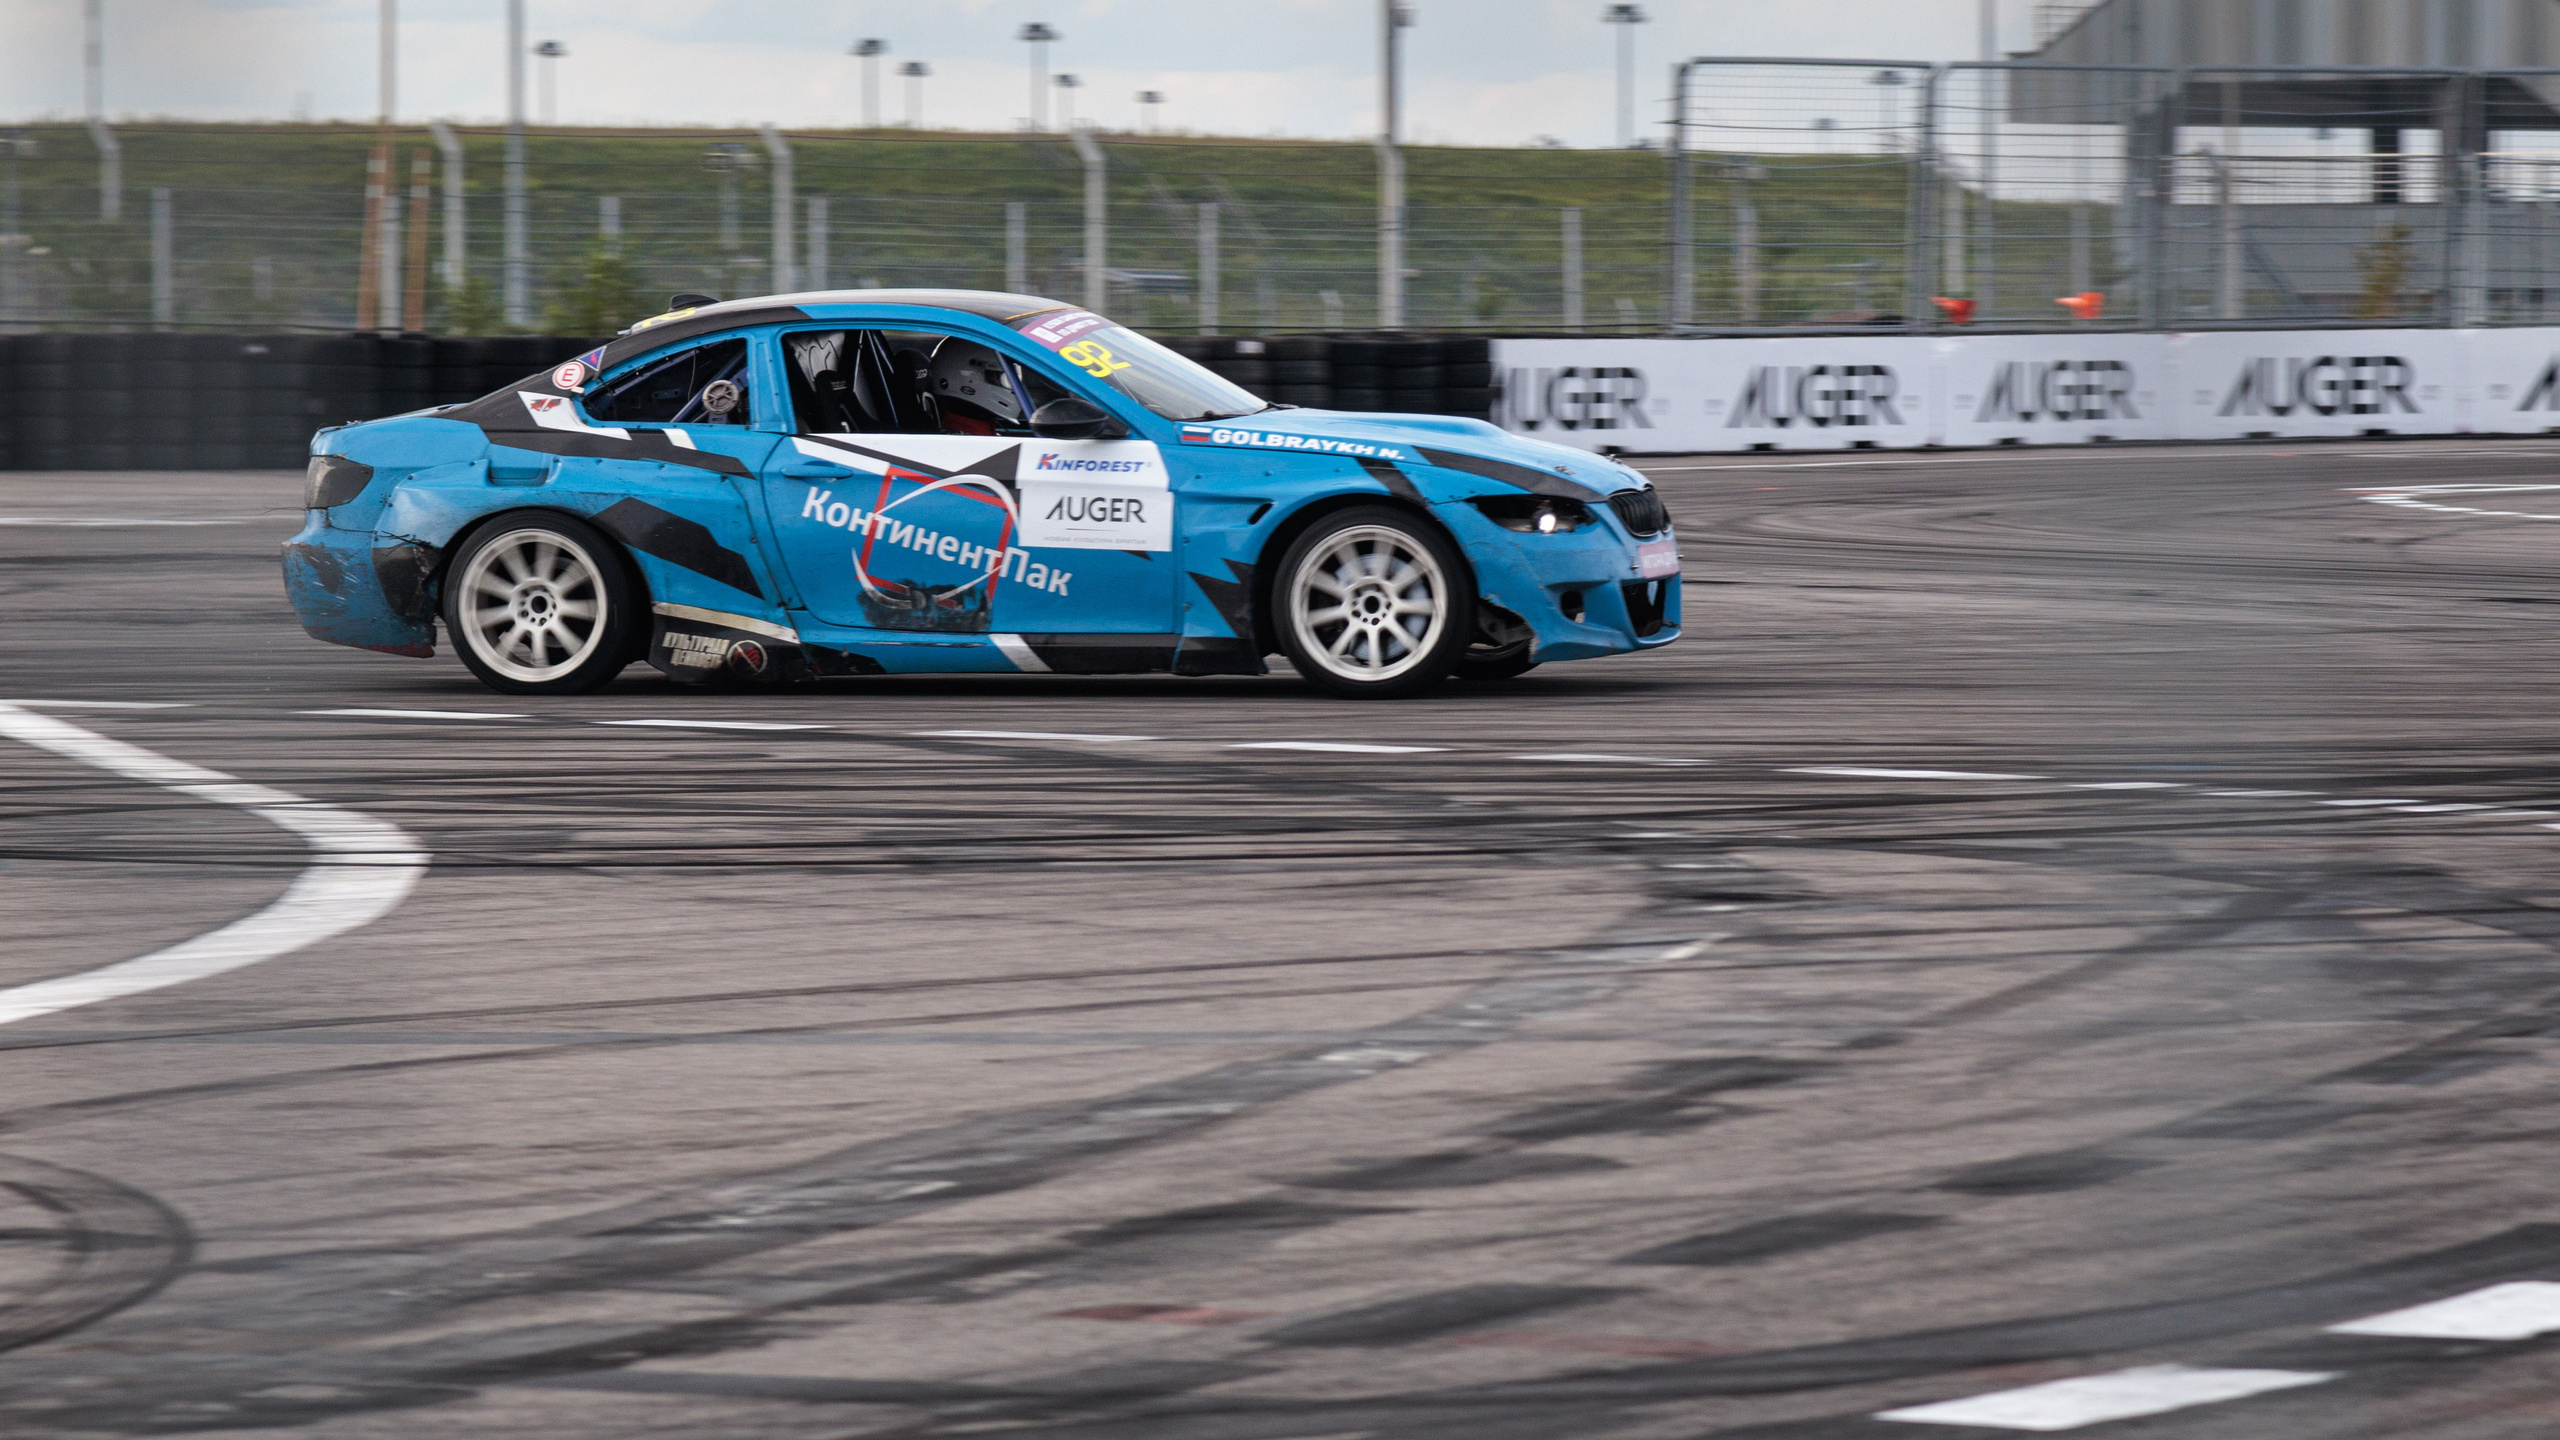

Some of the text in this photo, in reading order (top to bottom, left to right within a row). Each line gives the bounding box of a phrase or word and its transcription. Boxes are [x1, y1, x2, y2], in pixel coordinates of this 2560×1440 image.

[561, 369, 575, 382] E
[1058, 340, 1132, 378] 92
[1723, 365, 1906, 429] AUGER
[1972, 360, 2142, 423] AUGER
[2213, 355, 2425, 417] AUGER
[1212, 429, 1375, 455] GOLBRAYKH
[1036, 453, 1144, 472] KINFOREST
[1045, 495, 1147, 523] AUGER
[801, 486, 1073, 597] КонтинентПак
